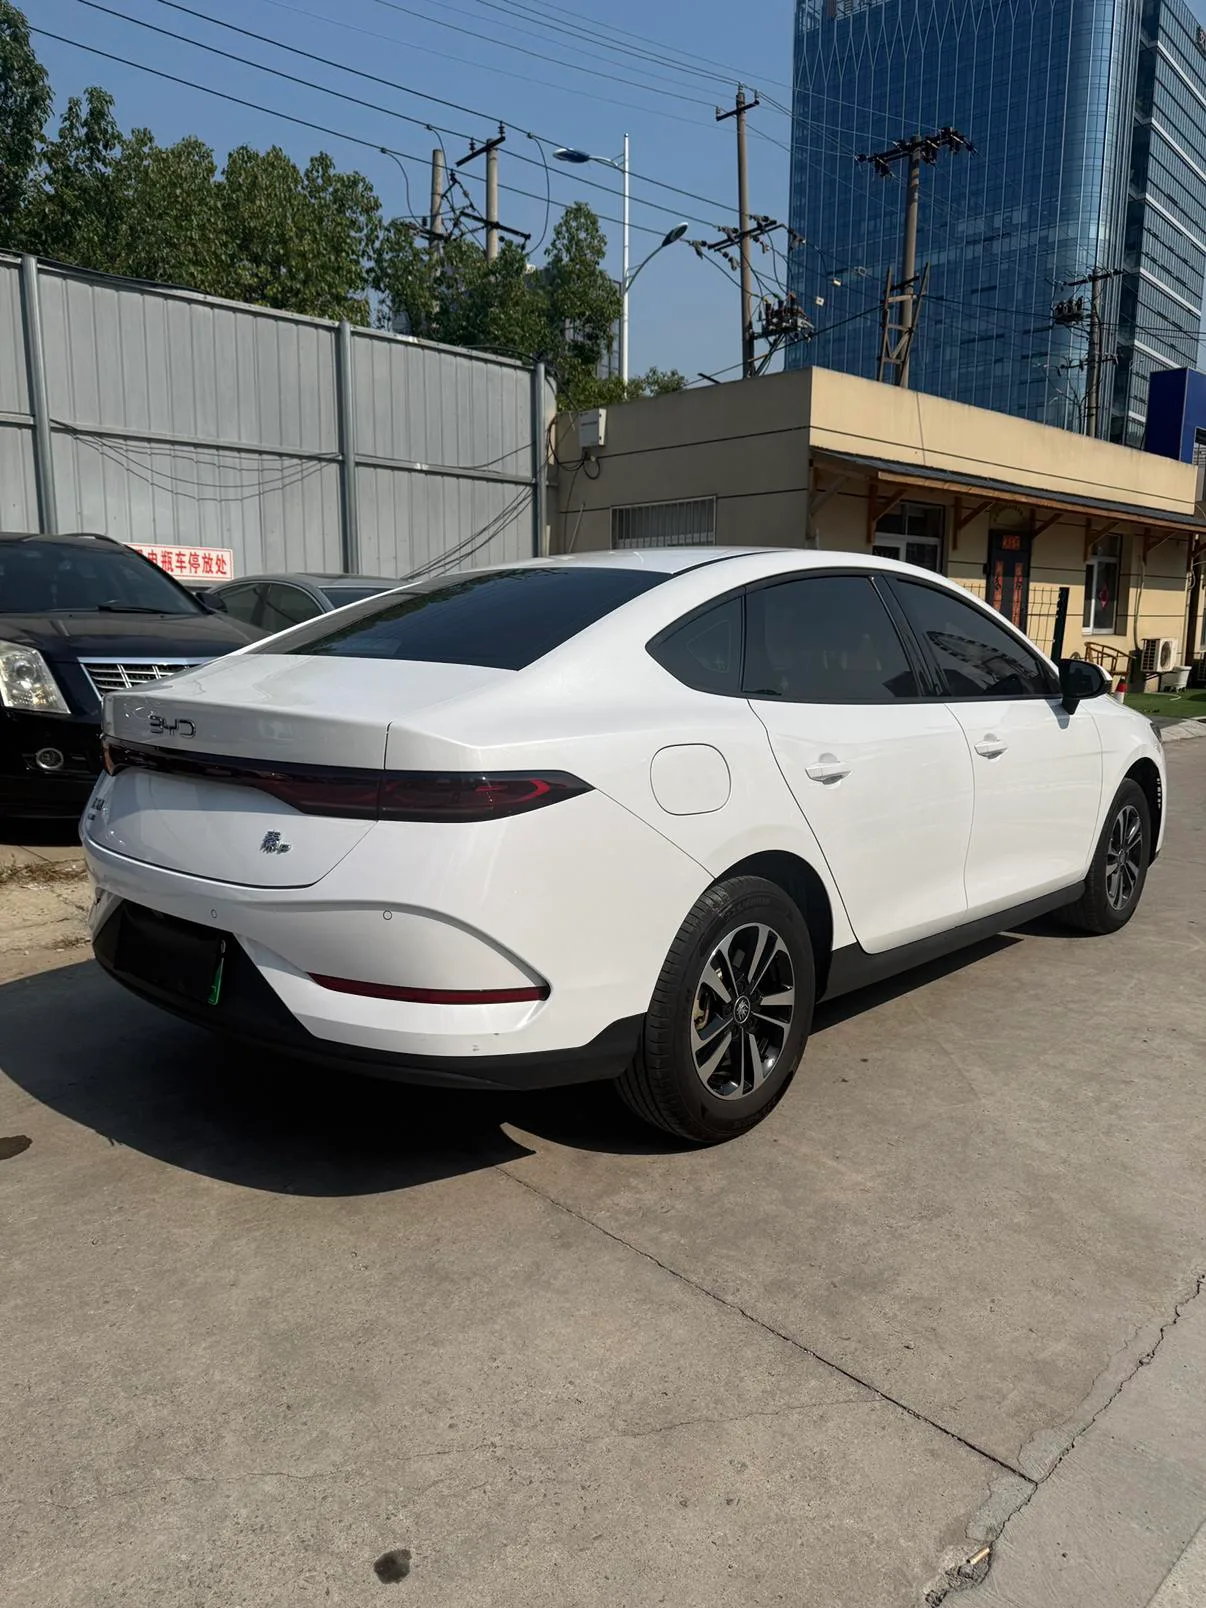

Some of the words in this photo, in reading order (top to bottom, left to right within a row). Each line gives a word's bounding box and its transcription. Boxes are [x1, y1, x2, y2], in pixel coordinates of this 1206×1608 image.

[136, 548, 227, 575] 电瓶车停放处
[150, 715, 195, 736] BYD
